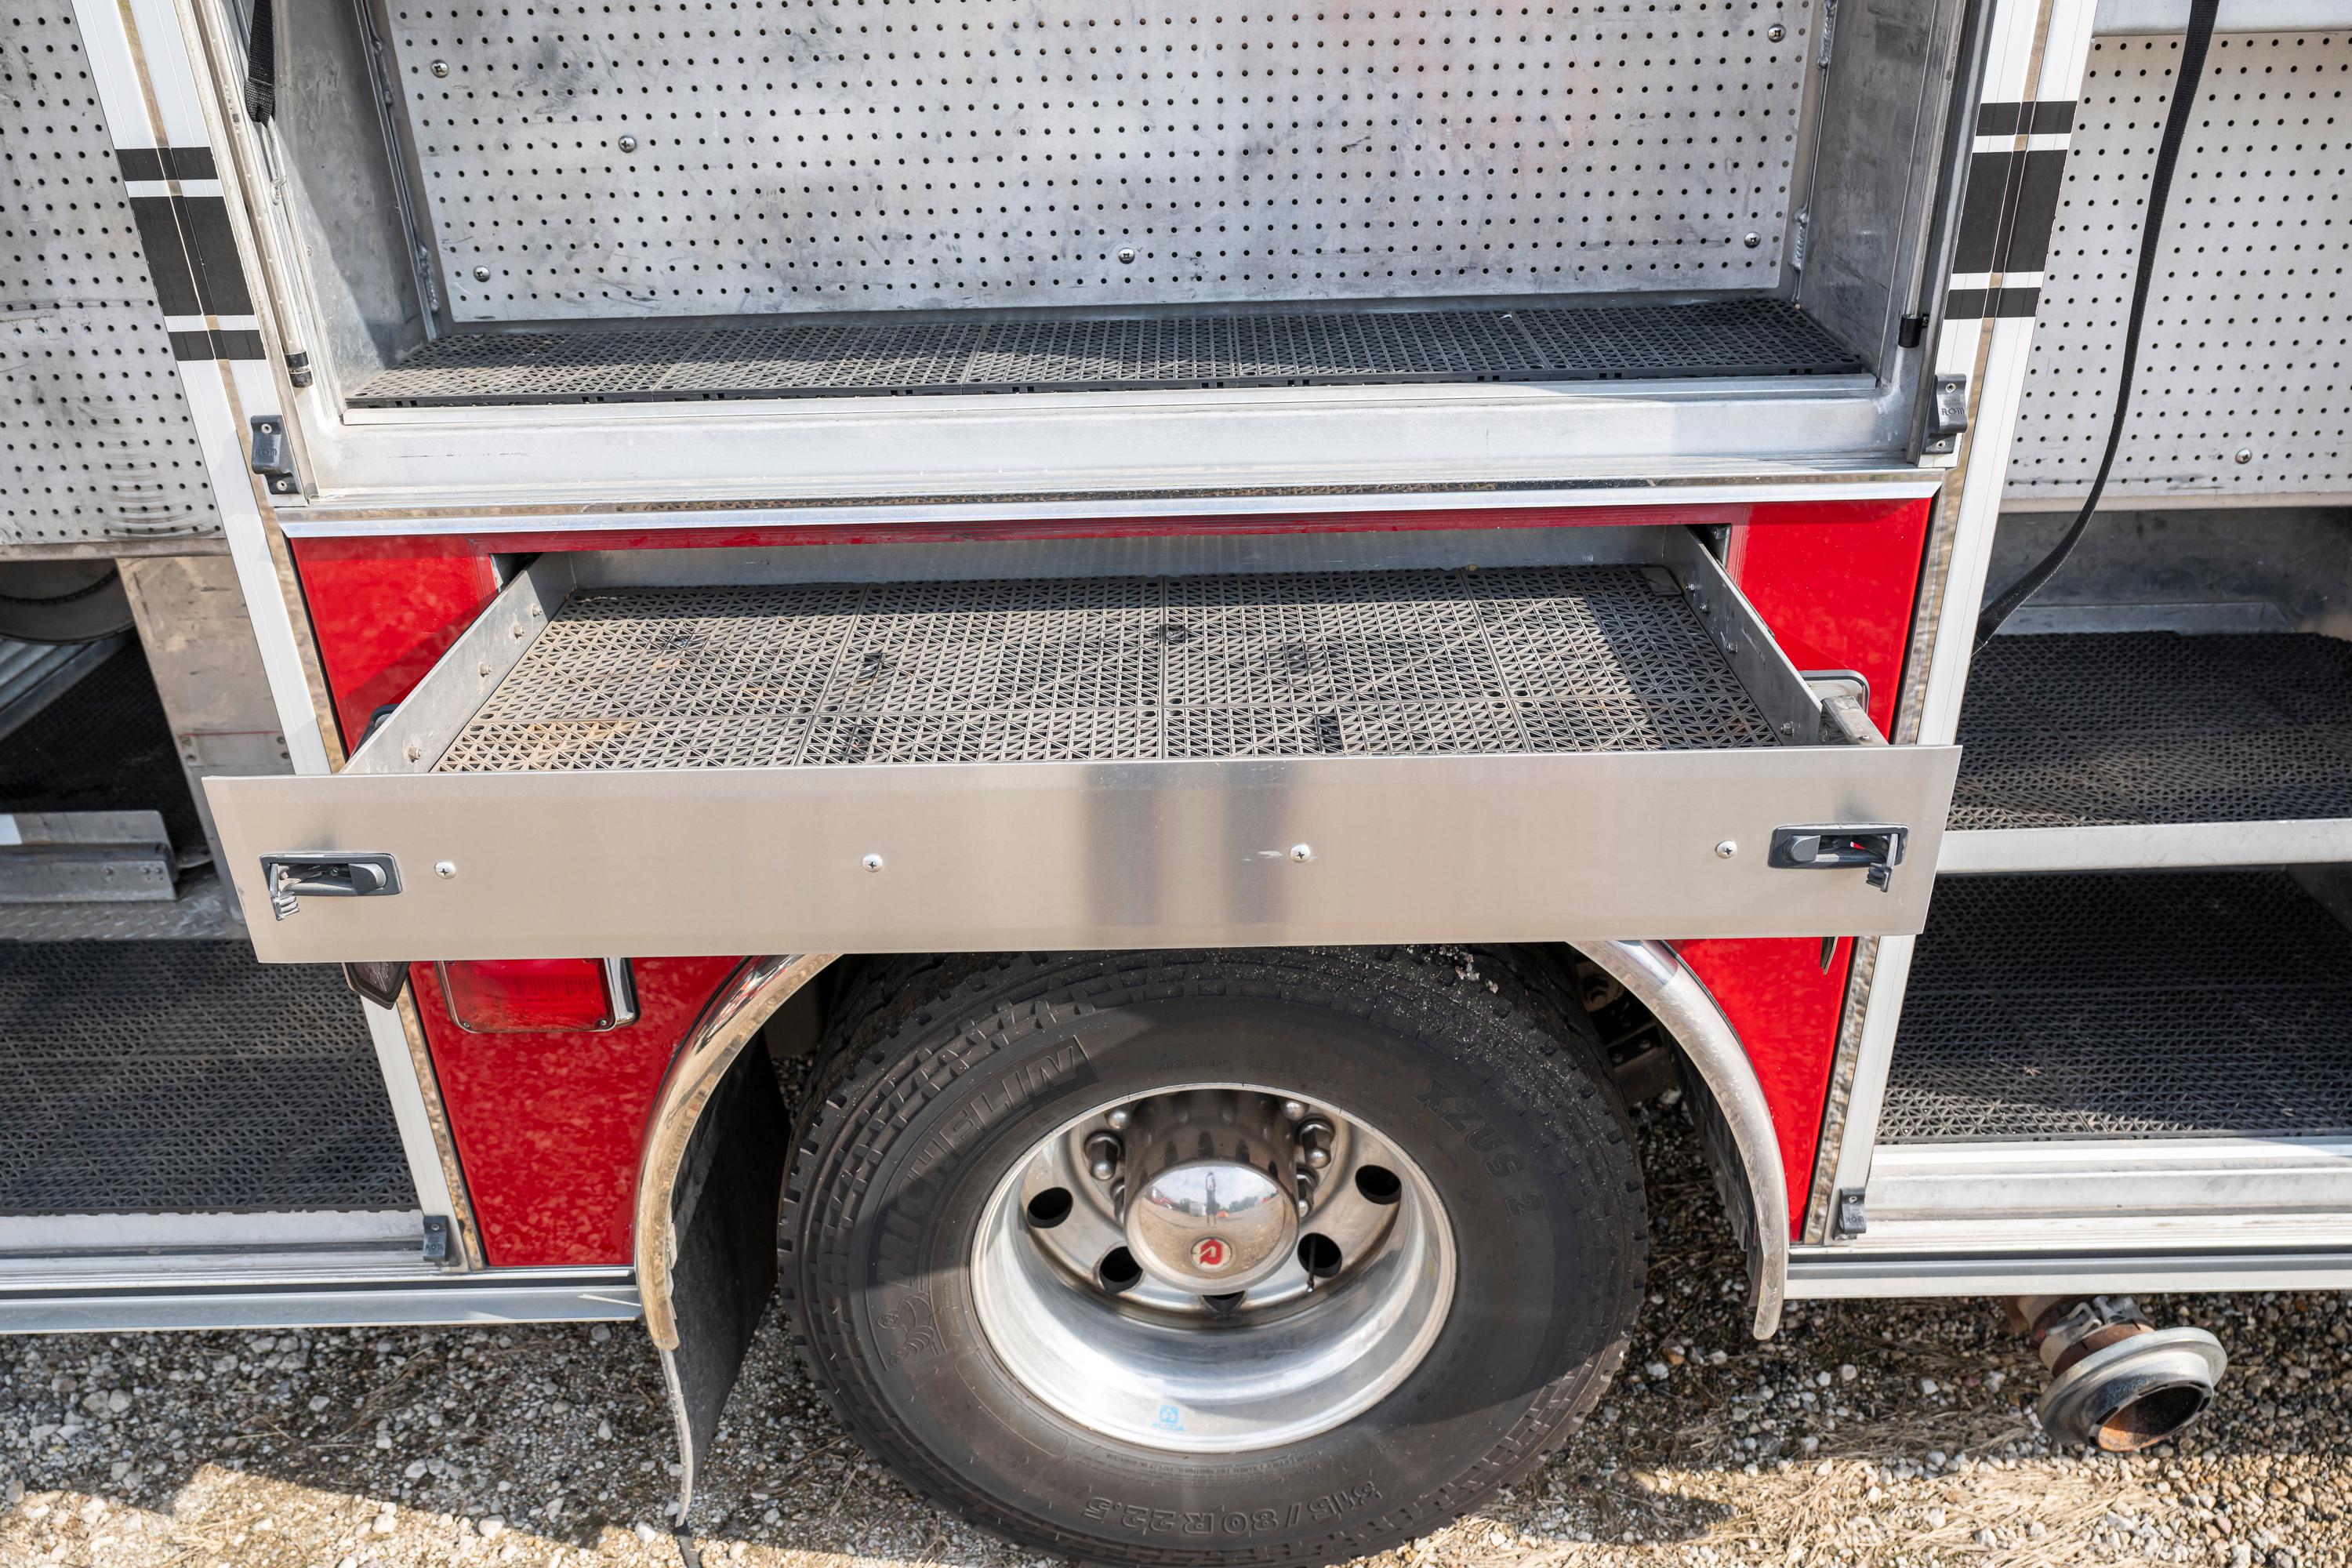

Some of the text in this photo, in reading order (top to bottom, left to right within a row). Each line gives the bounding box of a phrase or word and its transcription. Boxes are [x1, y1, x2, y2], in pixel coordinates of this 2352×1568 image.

[877, 1046, 1076, 1289] MICHELIN
[1411, 1078, 1544, 1216] XZUS 2
